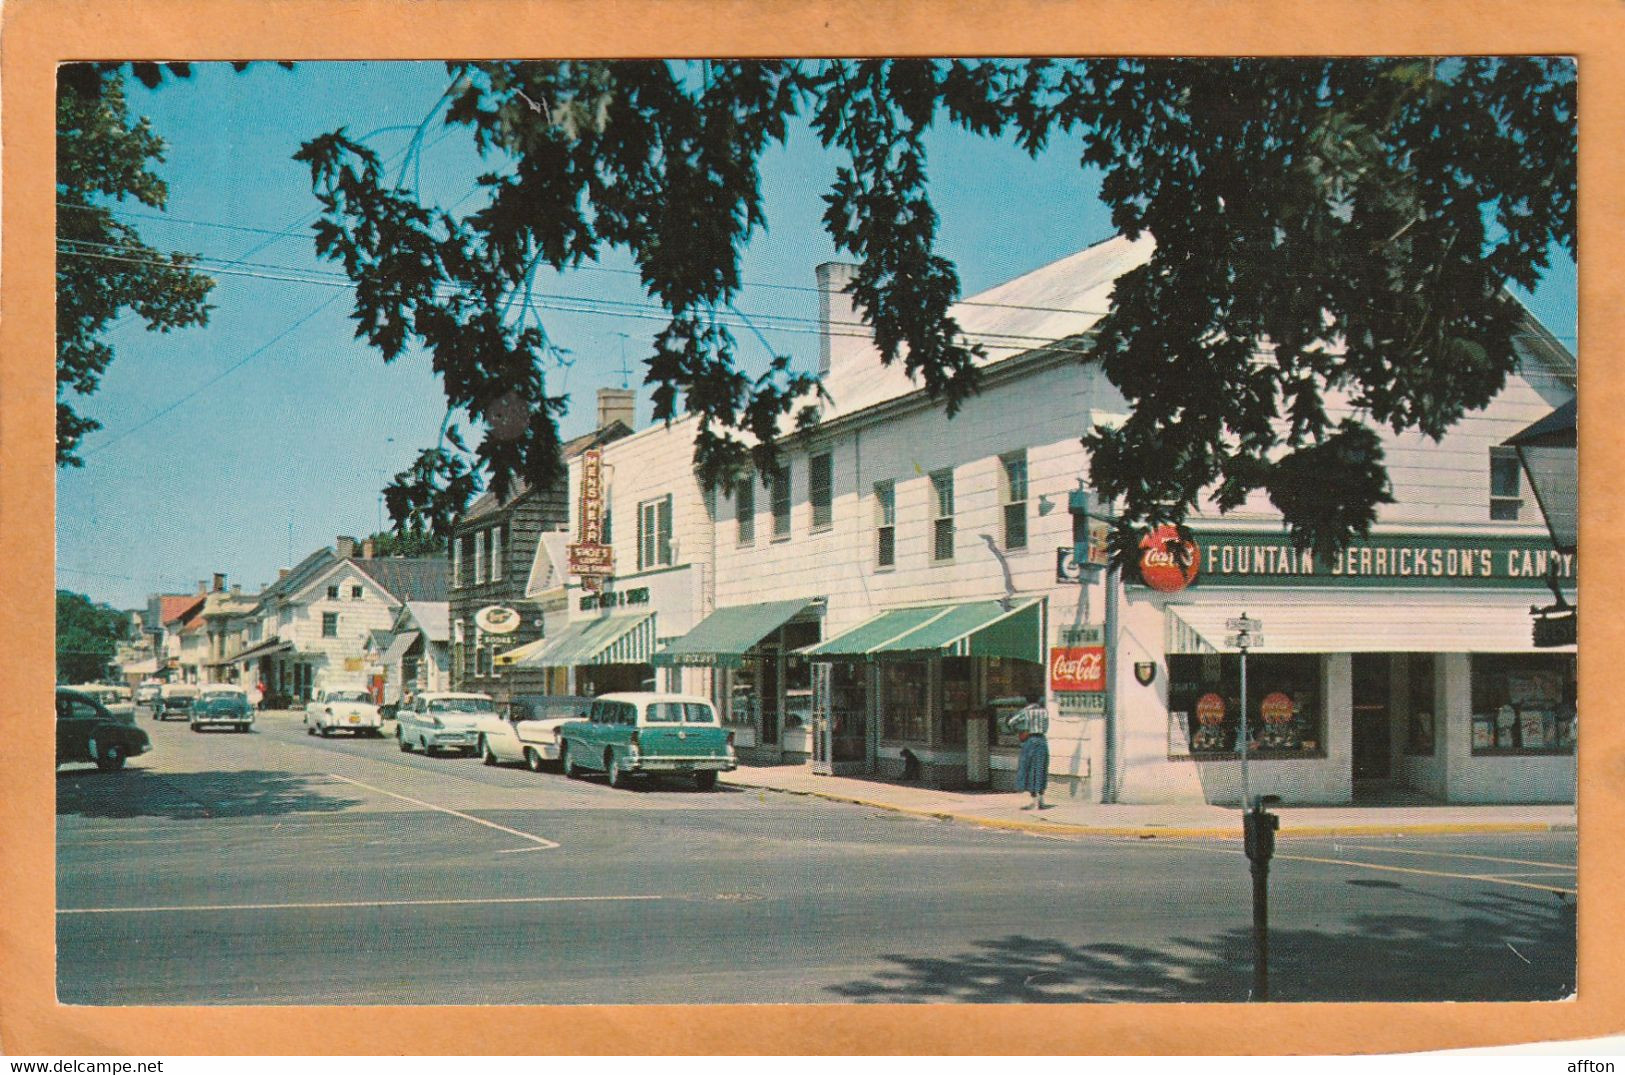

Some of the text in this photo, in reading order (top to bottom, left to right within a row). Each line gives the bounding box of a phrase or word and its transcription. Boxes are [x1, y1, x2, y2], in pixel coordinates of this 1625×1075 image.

[1207, 545, 1314, 574] FOUNTAIN
[1508, 548, 1573, 578] CANDY
[1052, 653, 1102, 682] Coca-Cola
